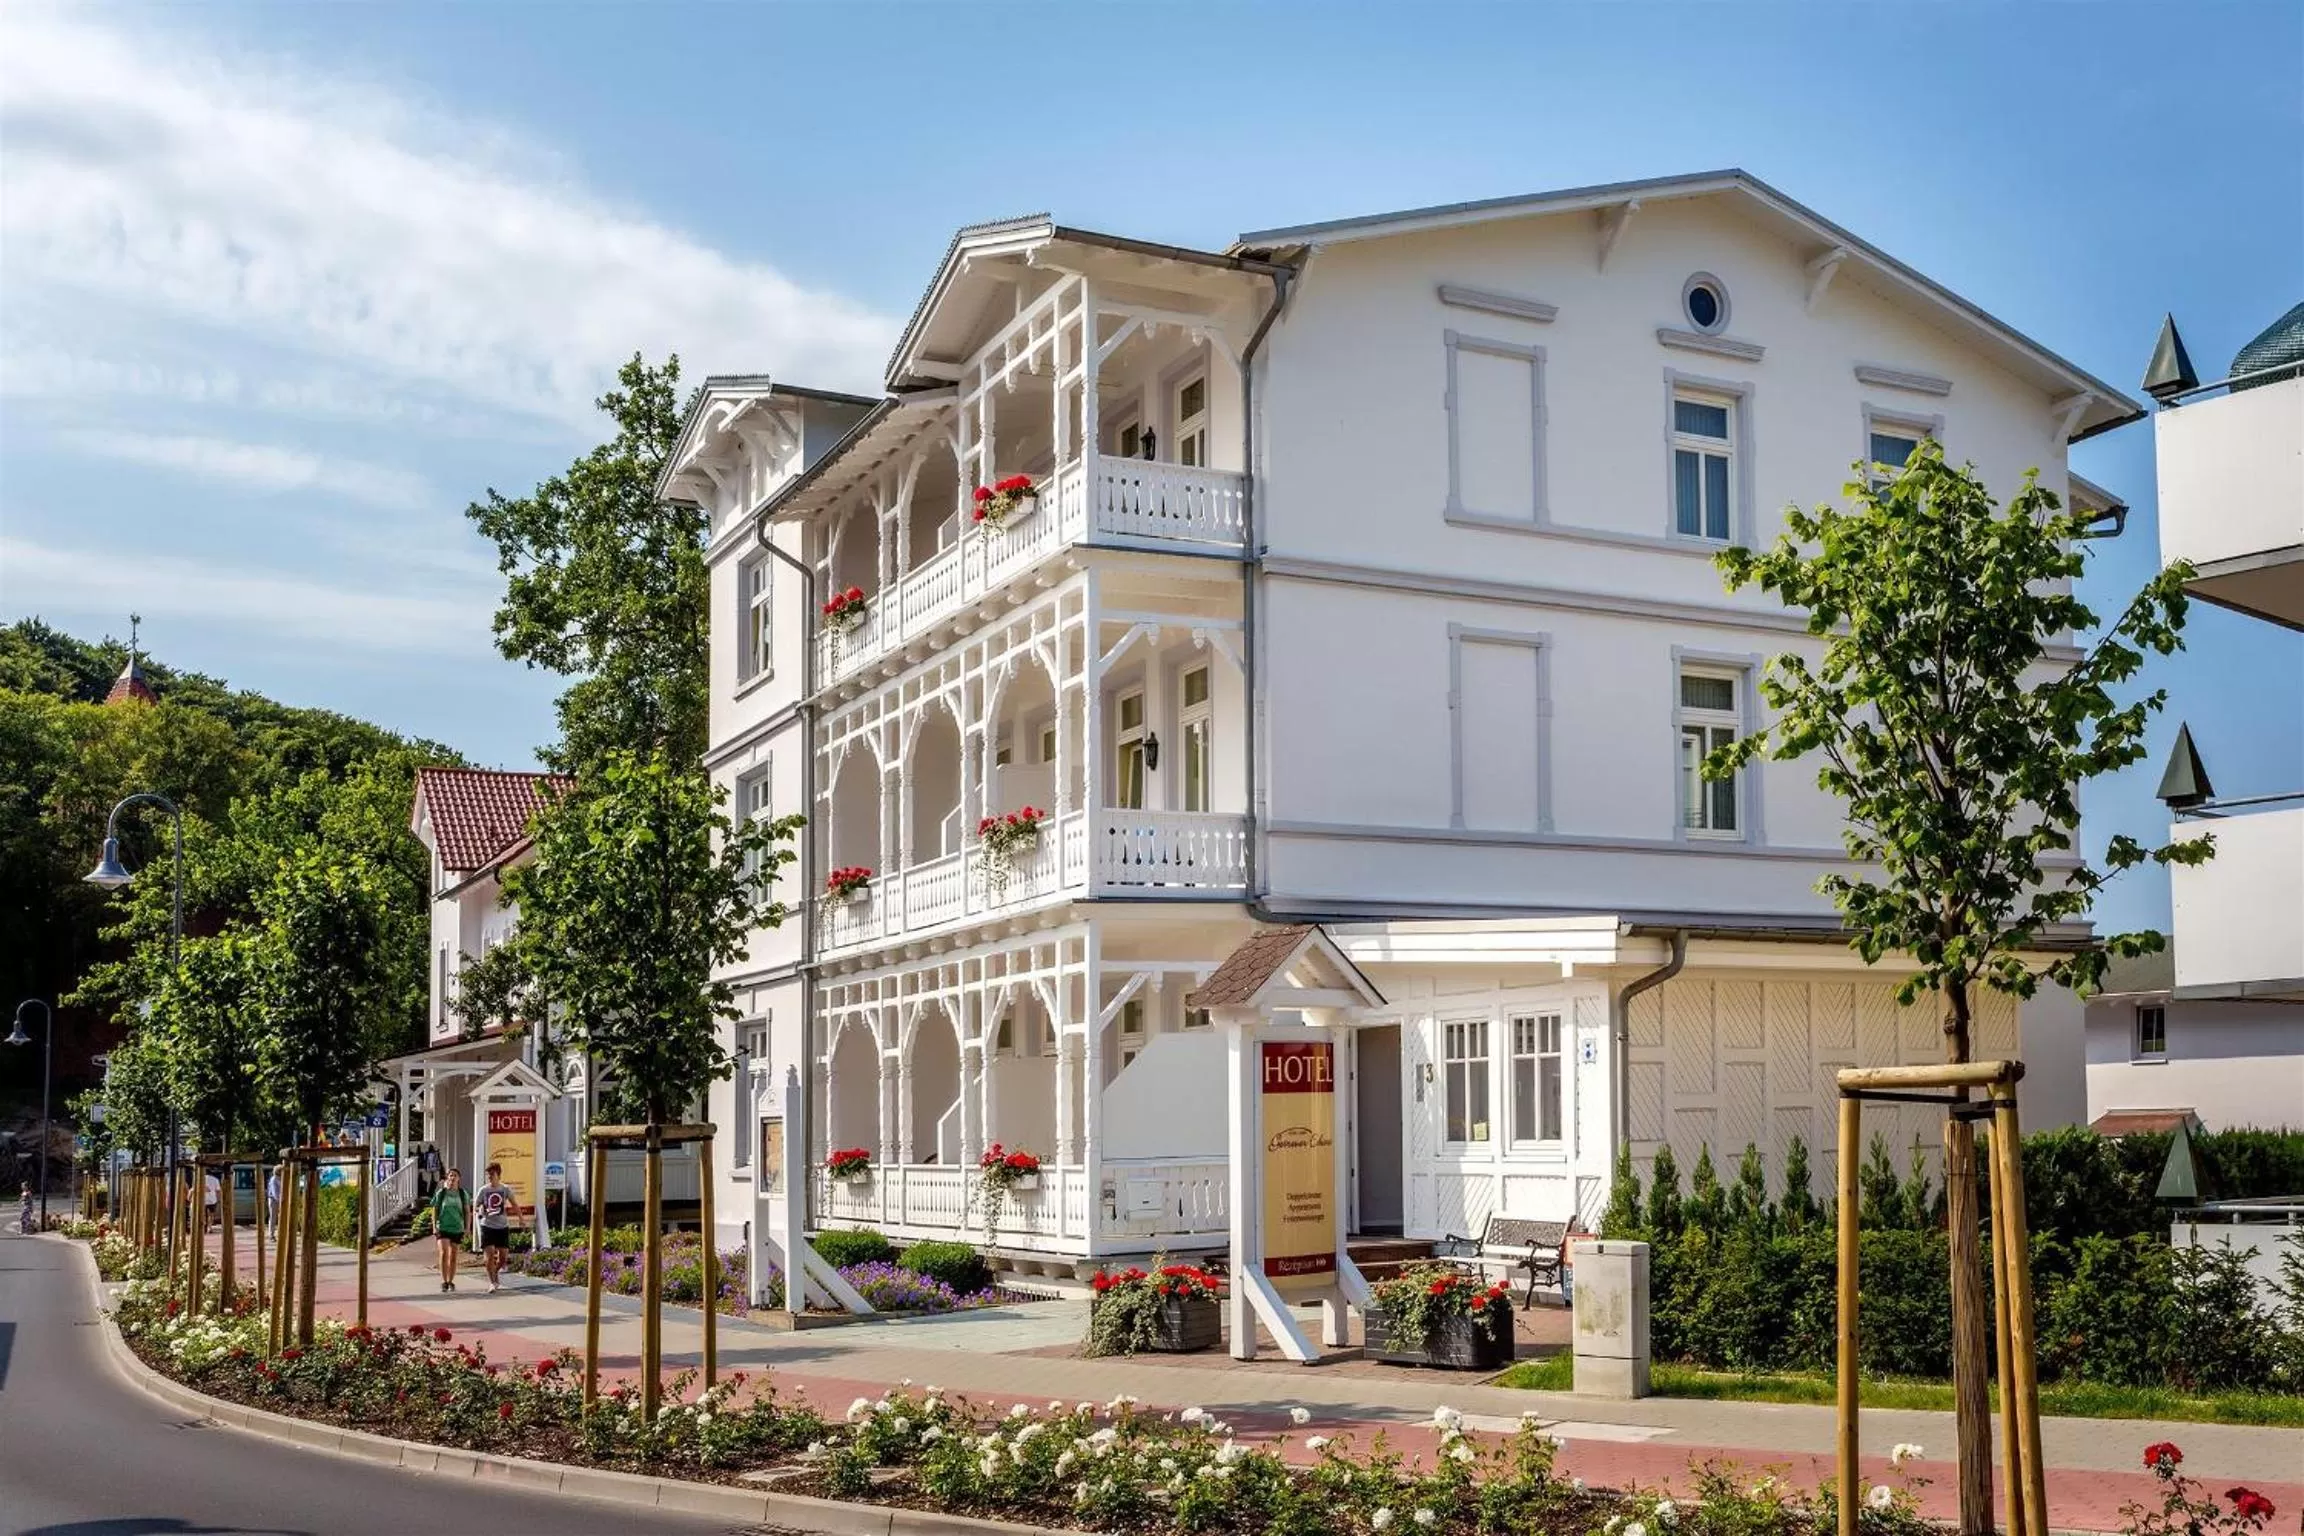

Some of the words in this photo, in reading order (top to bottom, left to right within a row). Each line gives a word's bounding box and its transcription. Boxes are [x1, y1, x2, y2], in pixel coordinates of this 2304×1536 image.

[1265, 1056, 1332, 1083] HOTEL
[1426, 1063, 1434, 1084] 3
[490, 1116, 534, 1130] HOTEL
